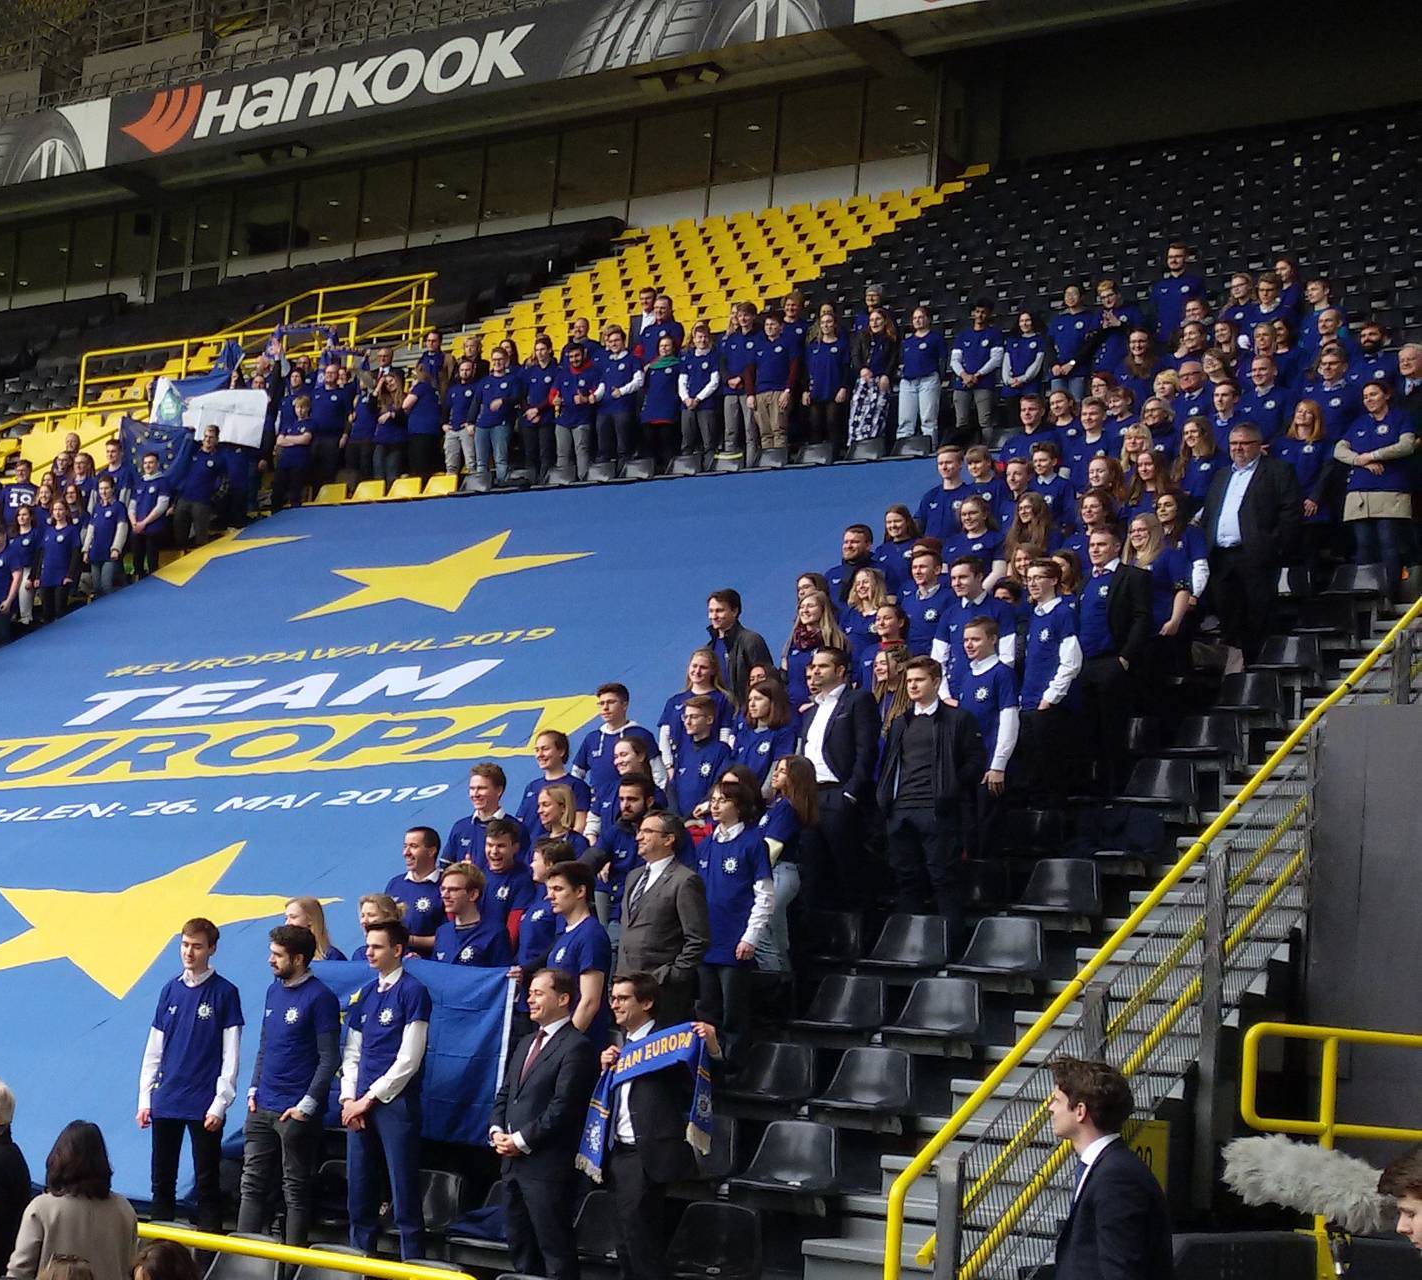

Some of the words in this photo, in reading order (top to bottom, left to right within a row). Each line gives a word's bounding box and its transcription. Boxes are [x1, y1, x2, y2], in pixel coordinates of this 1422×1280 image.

[105, 626, 556, 679] #EUROPAWAHL2019
[62, 658, 505, 728] TEAM
[129, 799, 199, 817] 26.
[213, 791, 322, 814] MAI
[322, 783, 450, 808] 2019
[616, 1048, 643, 1074] EAM
[644, 1031, 694, 1061] EUROPA
